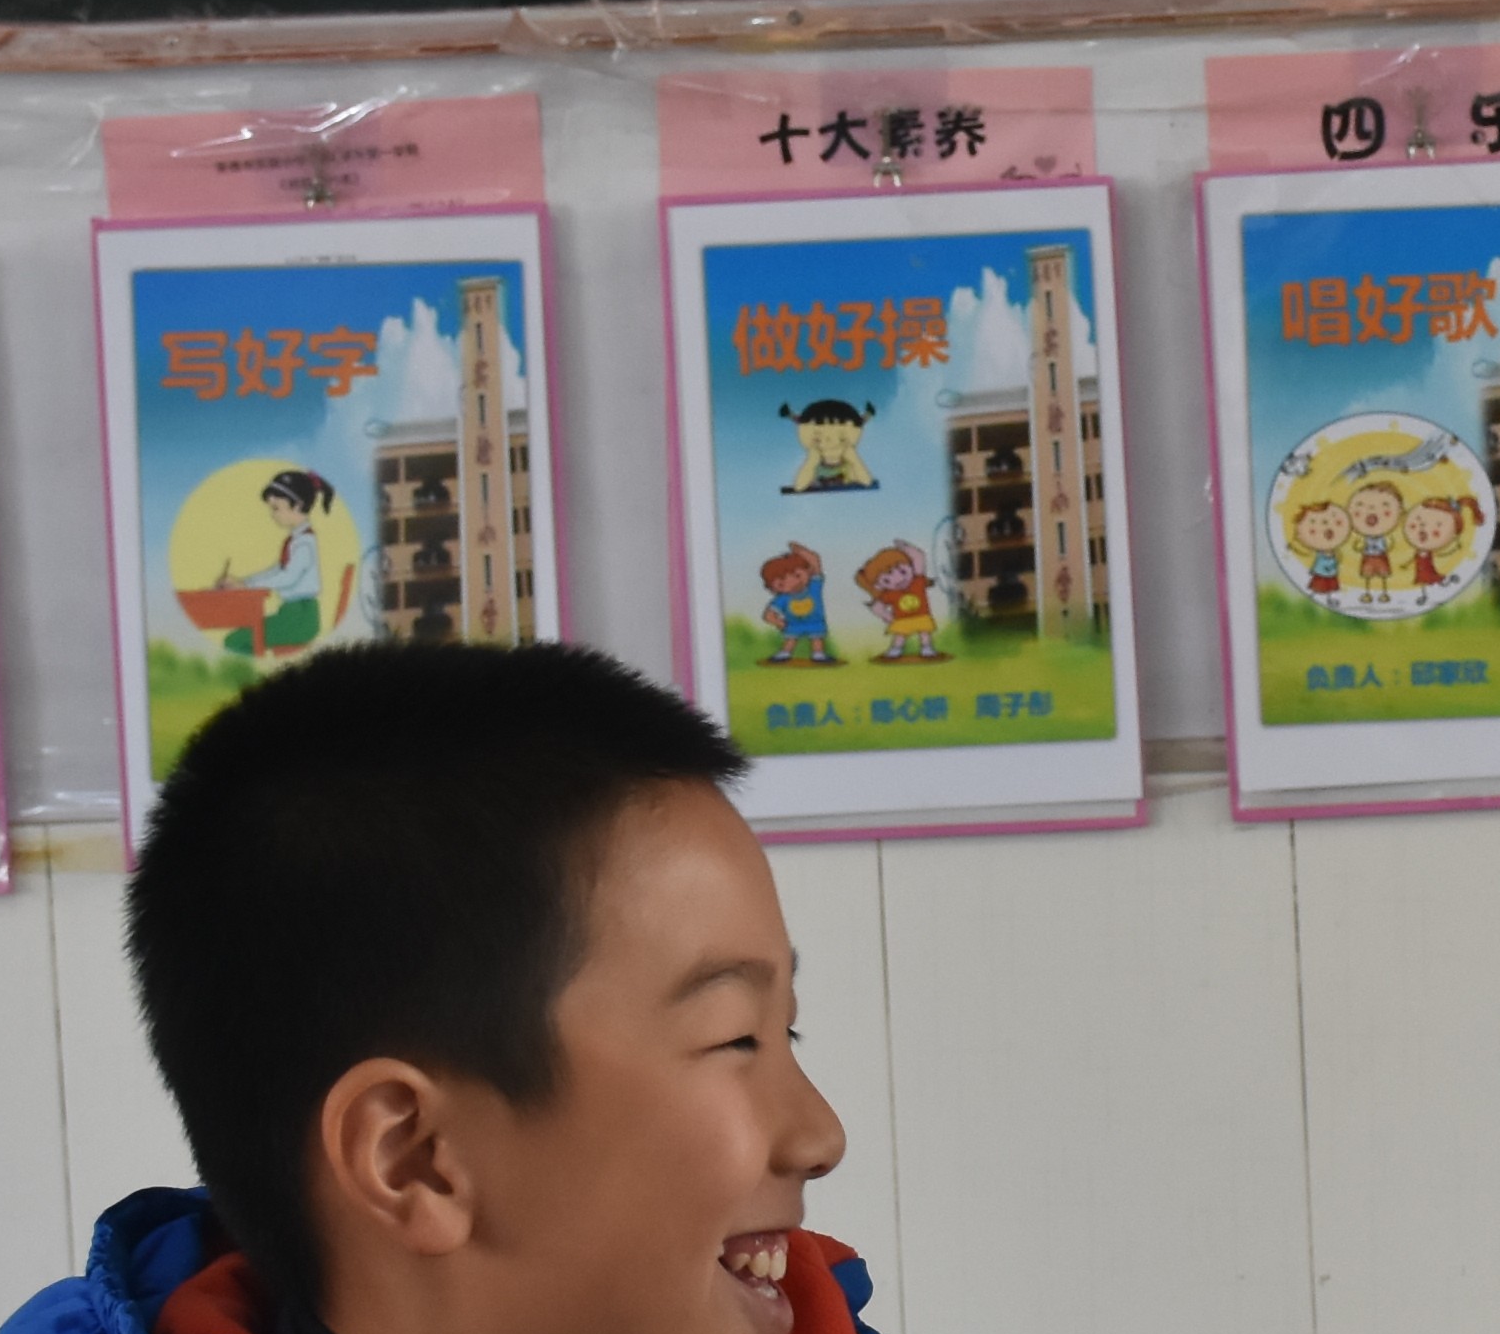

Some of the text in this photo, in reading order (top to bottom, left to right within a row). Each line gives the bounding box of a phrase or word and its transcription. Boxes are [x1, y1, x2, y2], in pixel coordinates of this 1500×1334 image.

[759, 108, 987, 164] 十大素养
[733, 296, 951, 377] 做好操
[1281, 272, 1499, 348] 唱好歌
[160, 326, 379, 401] 写好字
